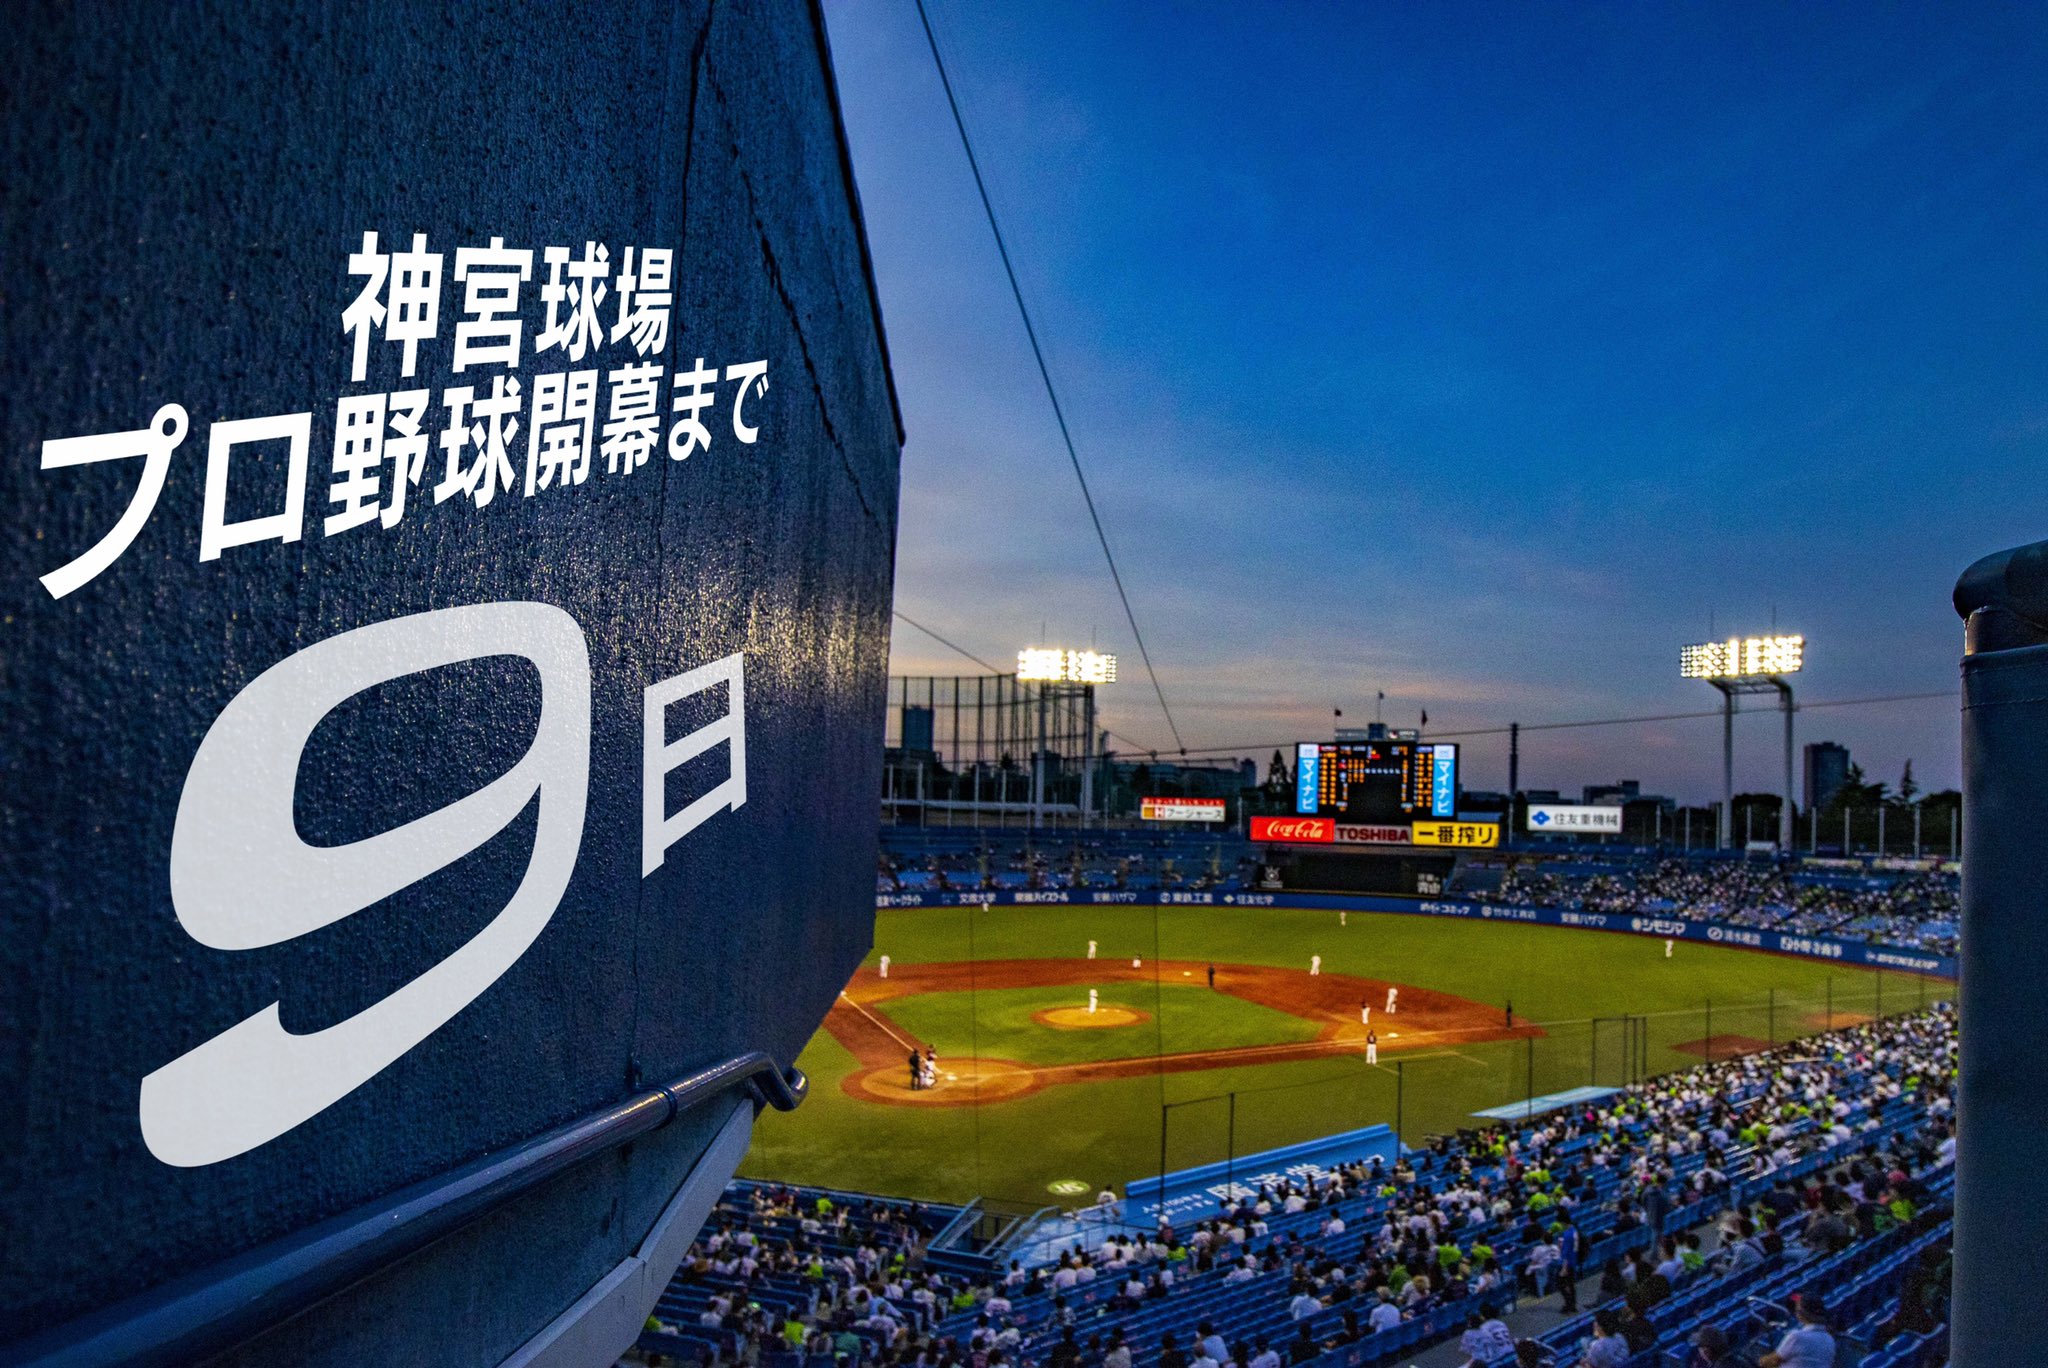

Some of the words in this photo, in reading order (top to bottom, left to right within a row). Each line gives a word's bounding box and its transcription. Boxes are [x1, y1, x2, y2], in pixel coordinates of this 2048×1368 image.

[342, 231, 674, 382] 神宮球場
[39, 357, 771, 600] プロ野球開幕まで
[1301, 758, 1315, 811] マイナビ
[1436, 760, 1451, 813] マイナビ
[1338, 827, 1410, 842] TOSHIBA
[1417, 824, 1494, 846] 一番搾り
[1553, 813, 1618, 827] 住友重機械
